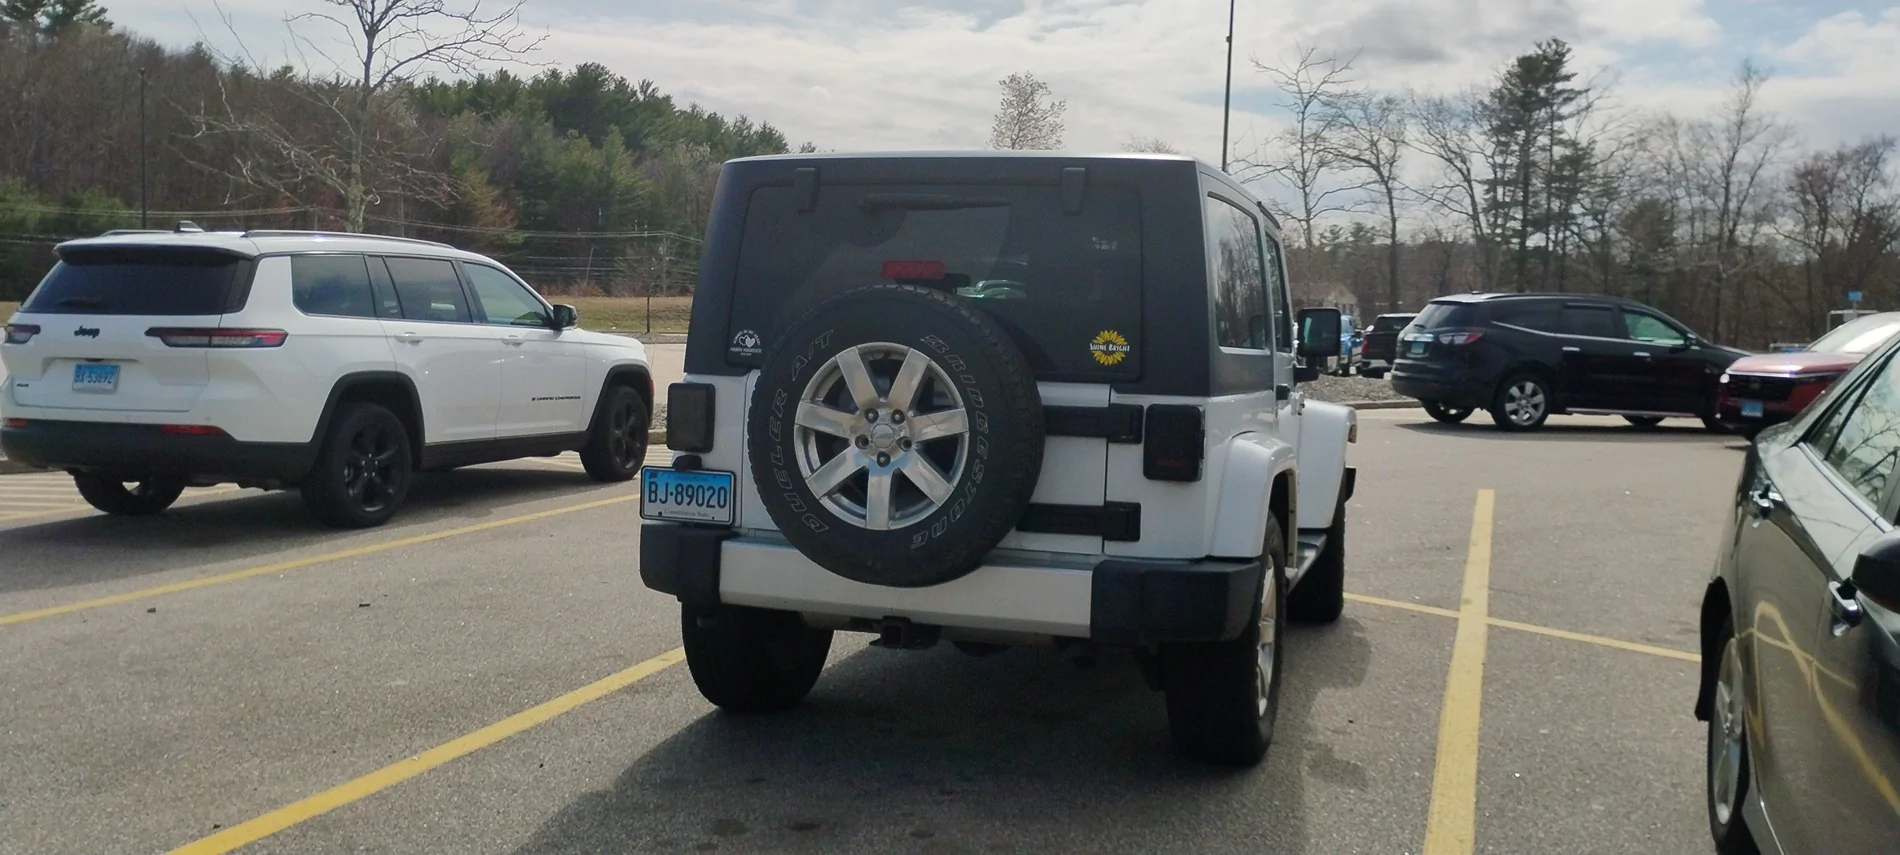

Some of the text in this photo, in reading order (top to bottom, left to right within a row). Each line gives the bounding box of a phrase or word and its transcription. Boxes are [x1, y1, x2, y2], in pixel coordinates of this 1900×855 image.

[74, 325, 100, 339] Jeep
[792, 329, 834, 382] A/T
[768, 388, 829, 533] DUELER
[911, 334, 989, 549] BRIDGESTONE
